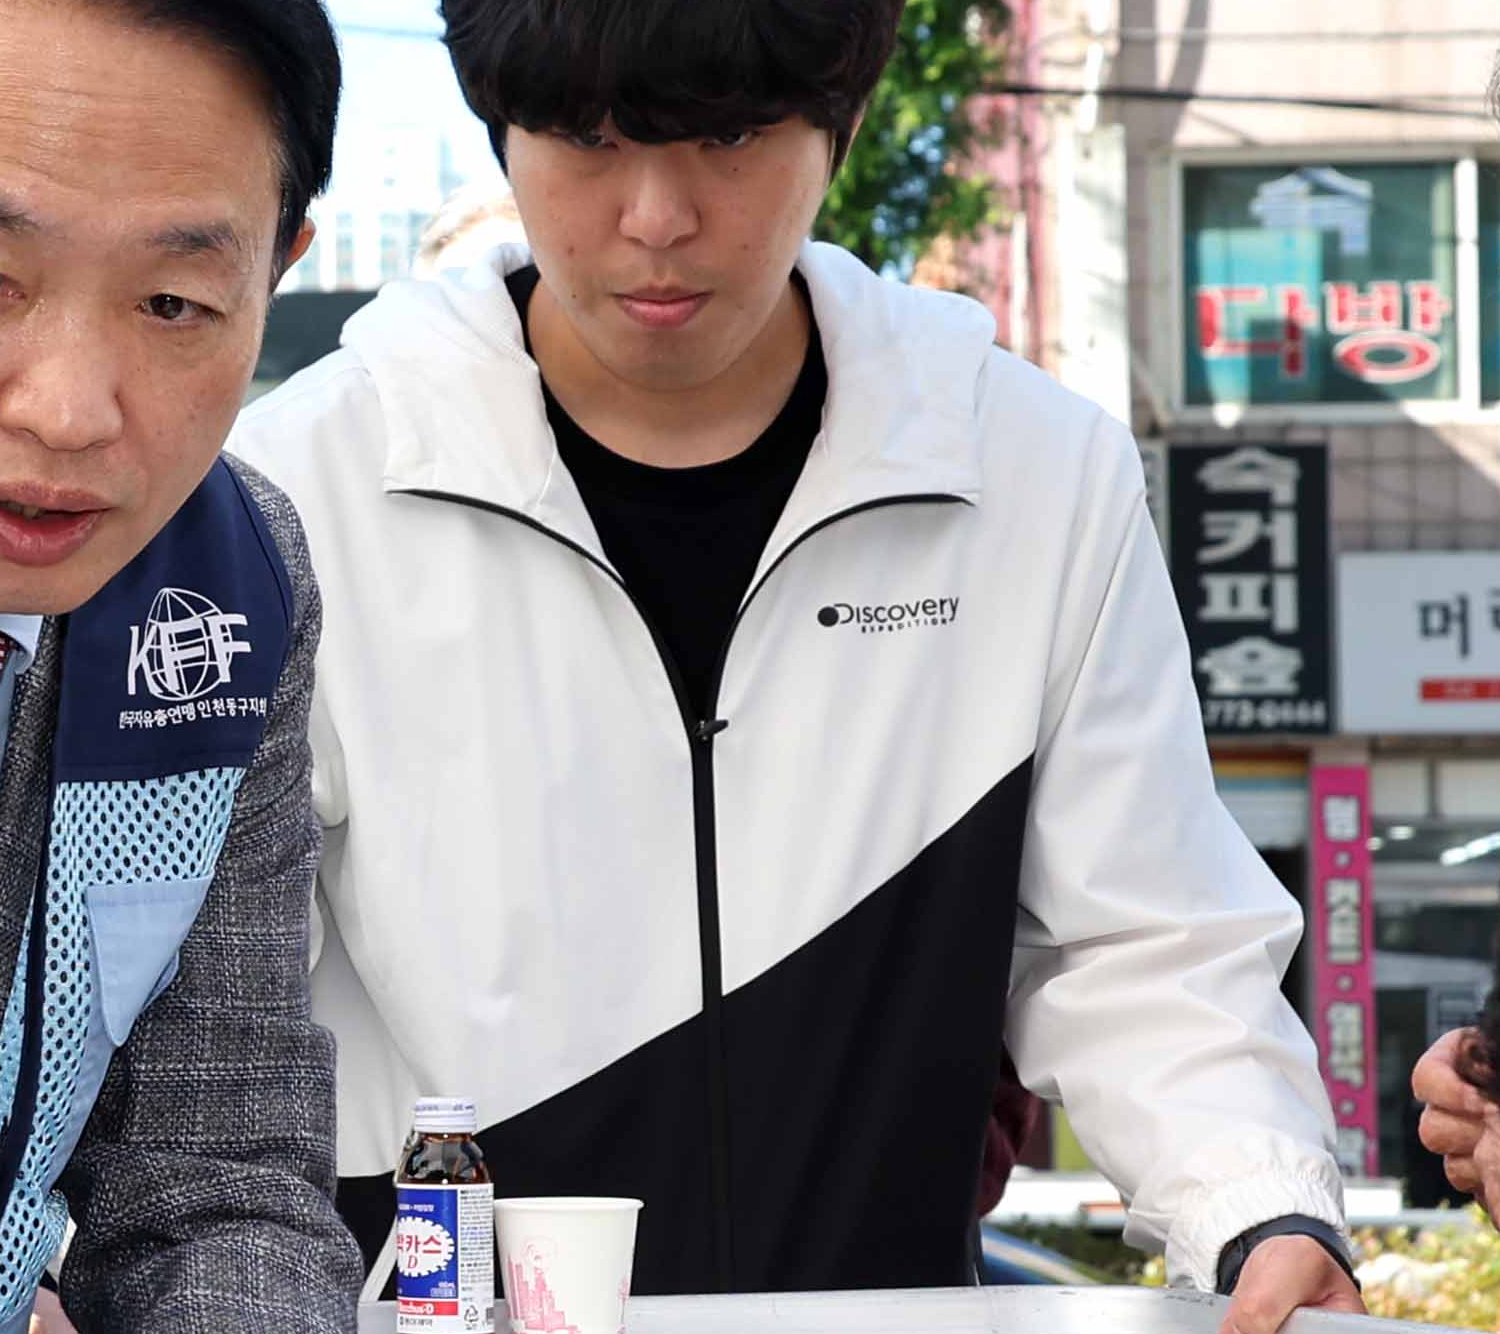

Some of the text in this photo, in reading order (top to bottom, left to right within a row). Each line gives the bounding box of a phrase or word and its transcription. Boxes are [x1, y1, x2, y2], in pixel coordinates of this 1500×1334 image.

[1193, 280, 1453, 383] 다방
[817, 596, 960, 628] Discovery
[407, 1255, 418, 1269] D
